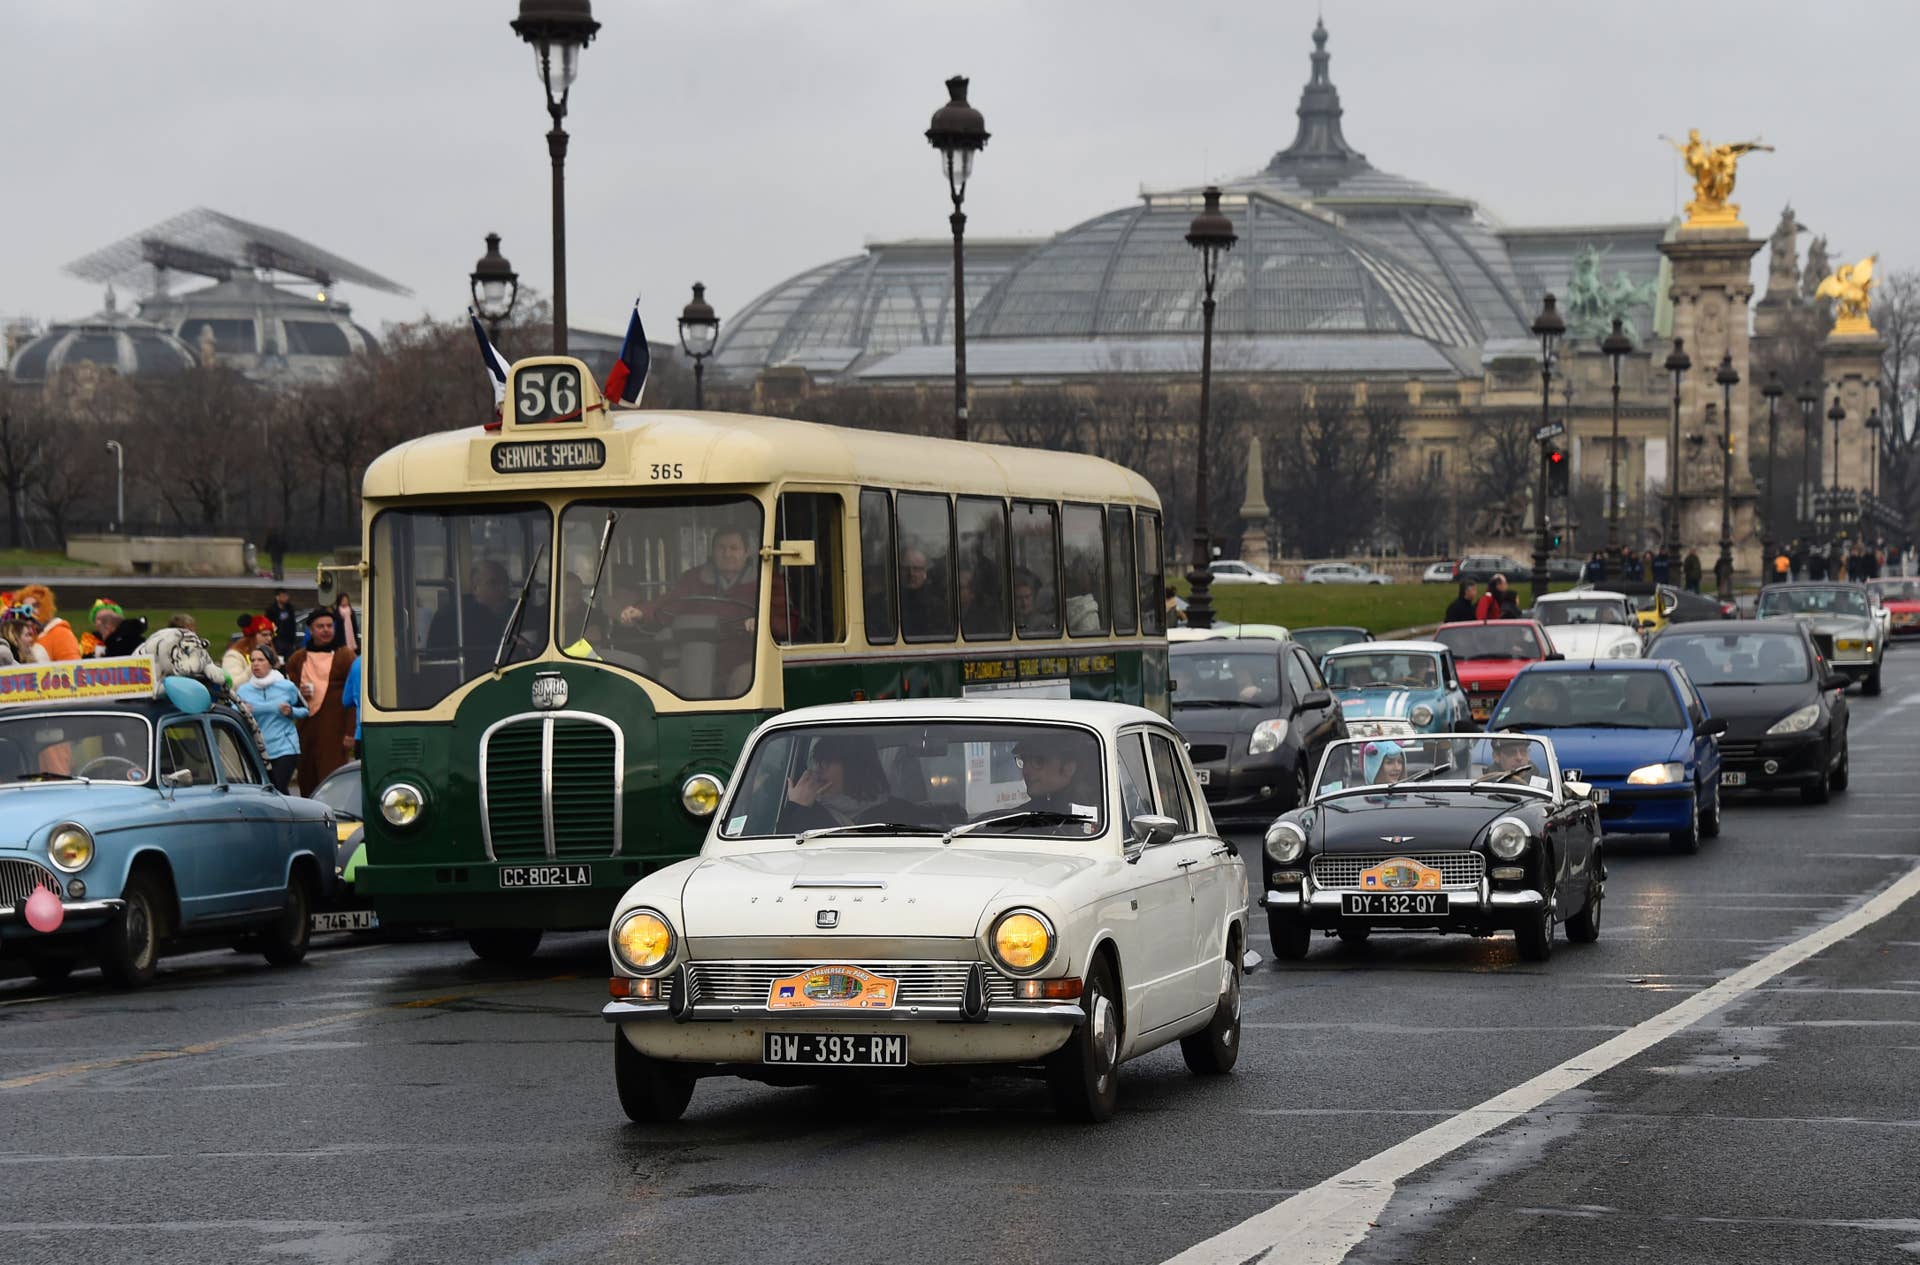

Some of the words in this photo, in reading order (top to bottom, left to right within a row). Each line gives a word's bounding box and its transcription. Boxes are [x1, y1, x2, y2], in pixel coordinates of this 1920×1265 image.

[519, 371, 577, 417] 56
[497, 444, 548, 469] SERVICE
[551, 442, 601, 467] SPECIAL
[650, 463, 683, 480] 365
[40, 671, 71, 691] des
[532, 679, 567, 701] SOMUA
[769, 1034, 901, 1063] BW-393-RM
